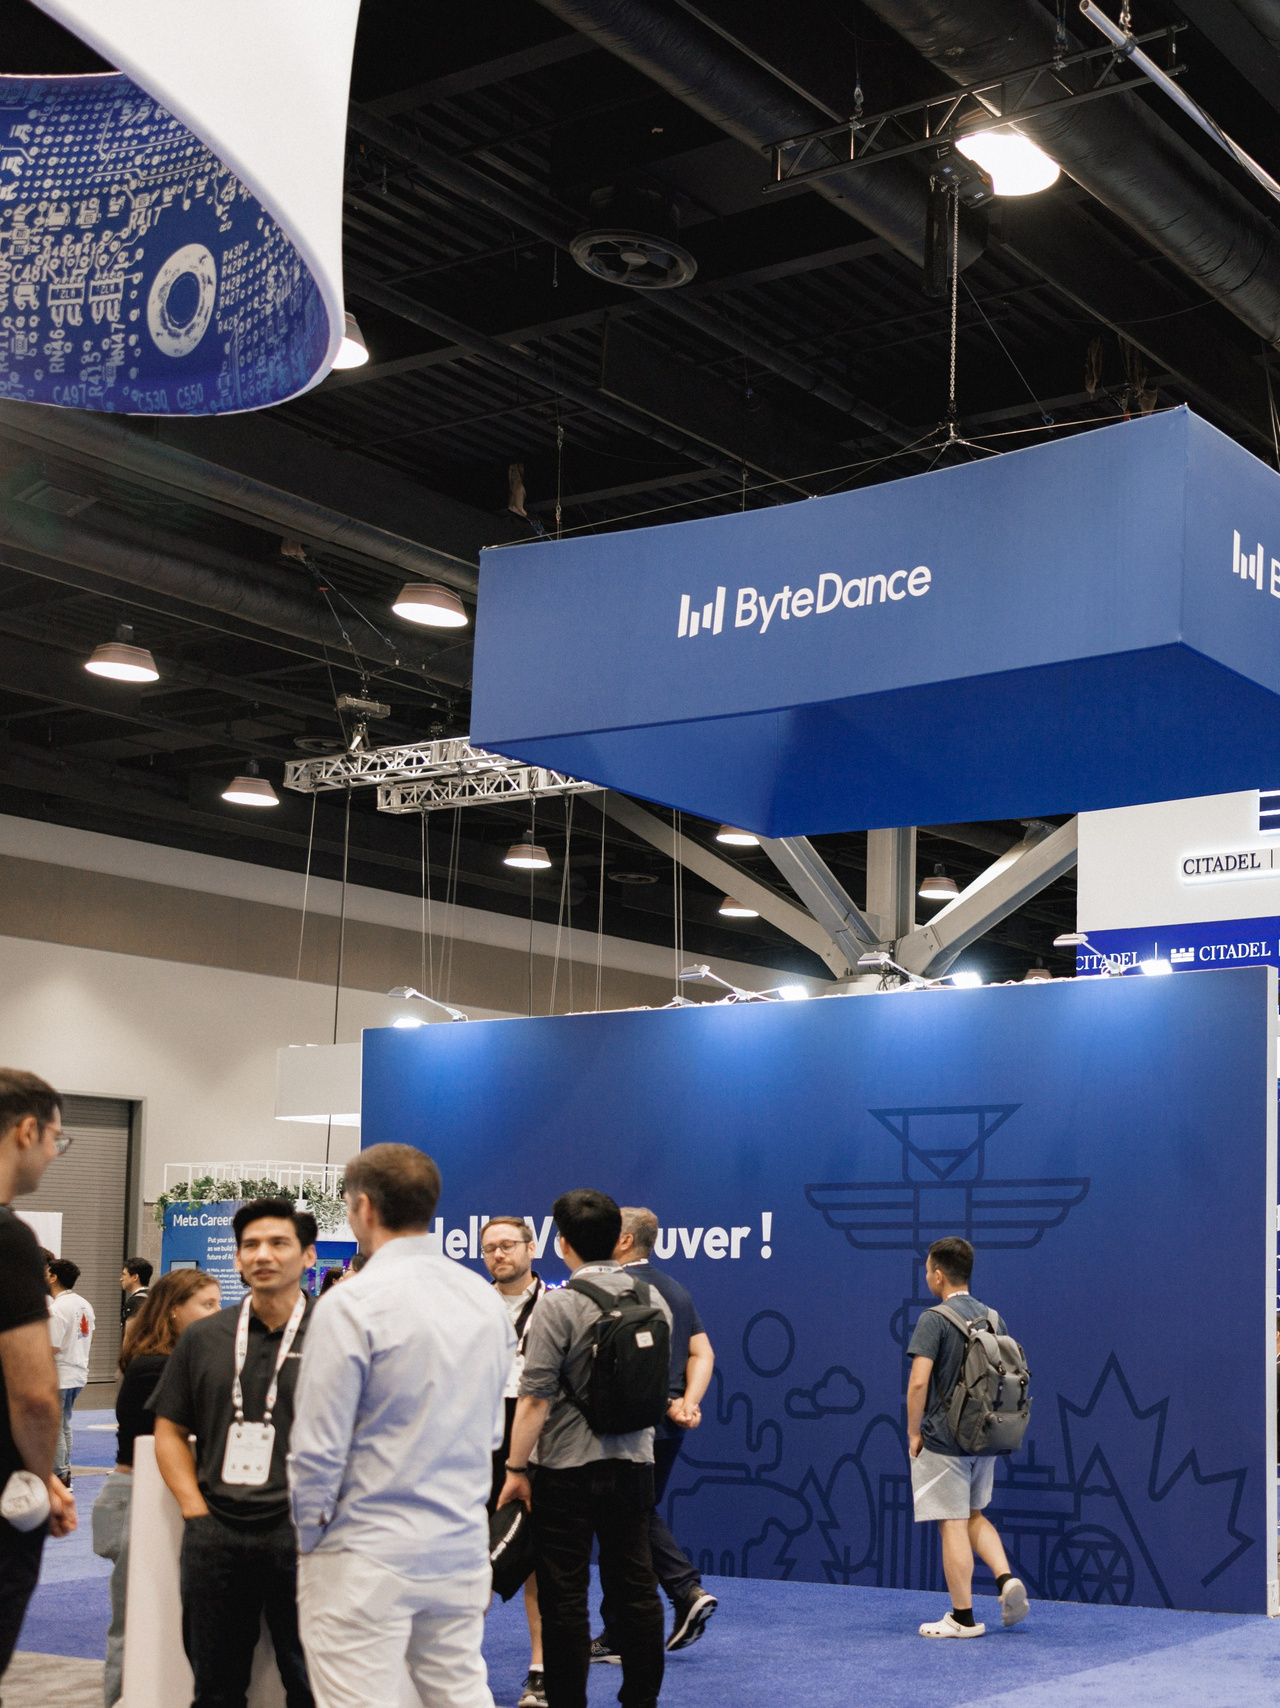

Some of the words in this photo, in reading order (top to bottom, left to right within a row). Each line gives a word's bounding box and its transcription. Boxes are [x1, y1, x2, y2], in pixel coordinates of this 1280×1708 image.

[735, 566, 932, 634] ByteDance
[1183, 852, 1261, 875] CITADEL
[1198, 941, 1272, 962] CITADEL
[173, 1214, 198, 1227] Meta
[200, 1213, 234, 1226] Career
